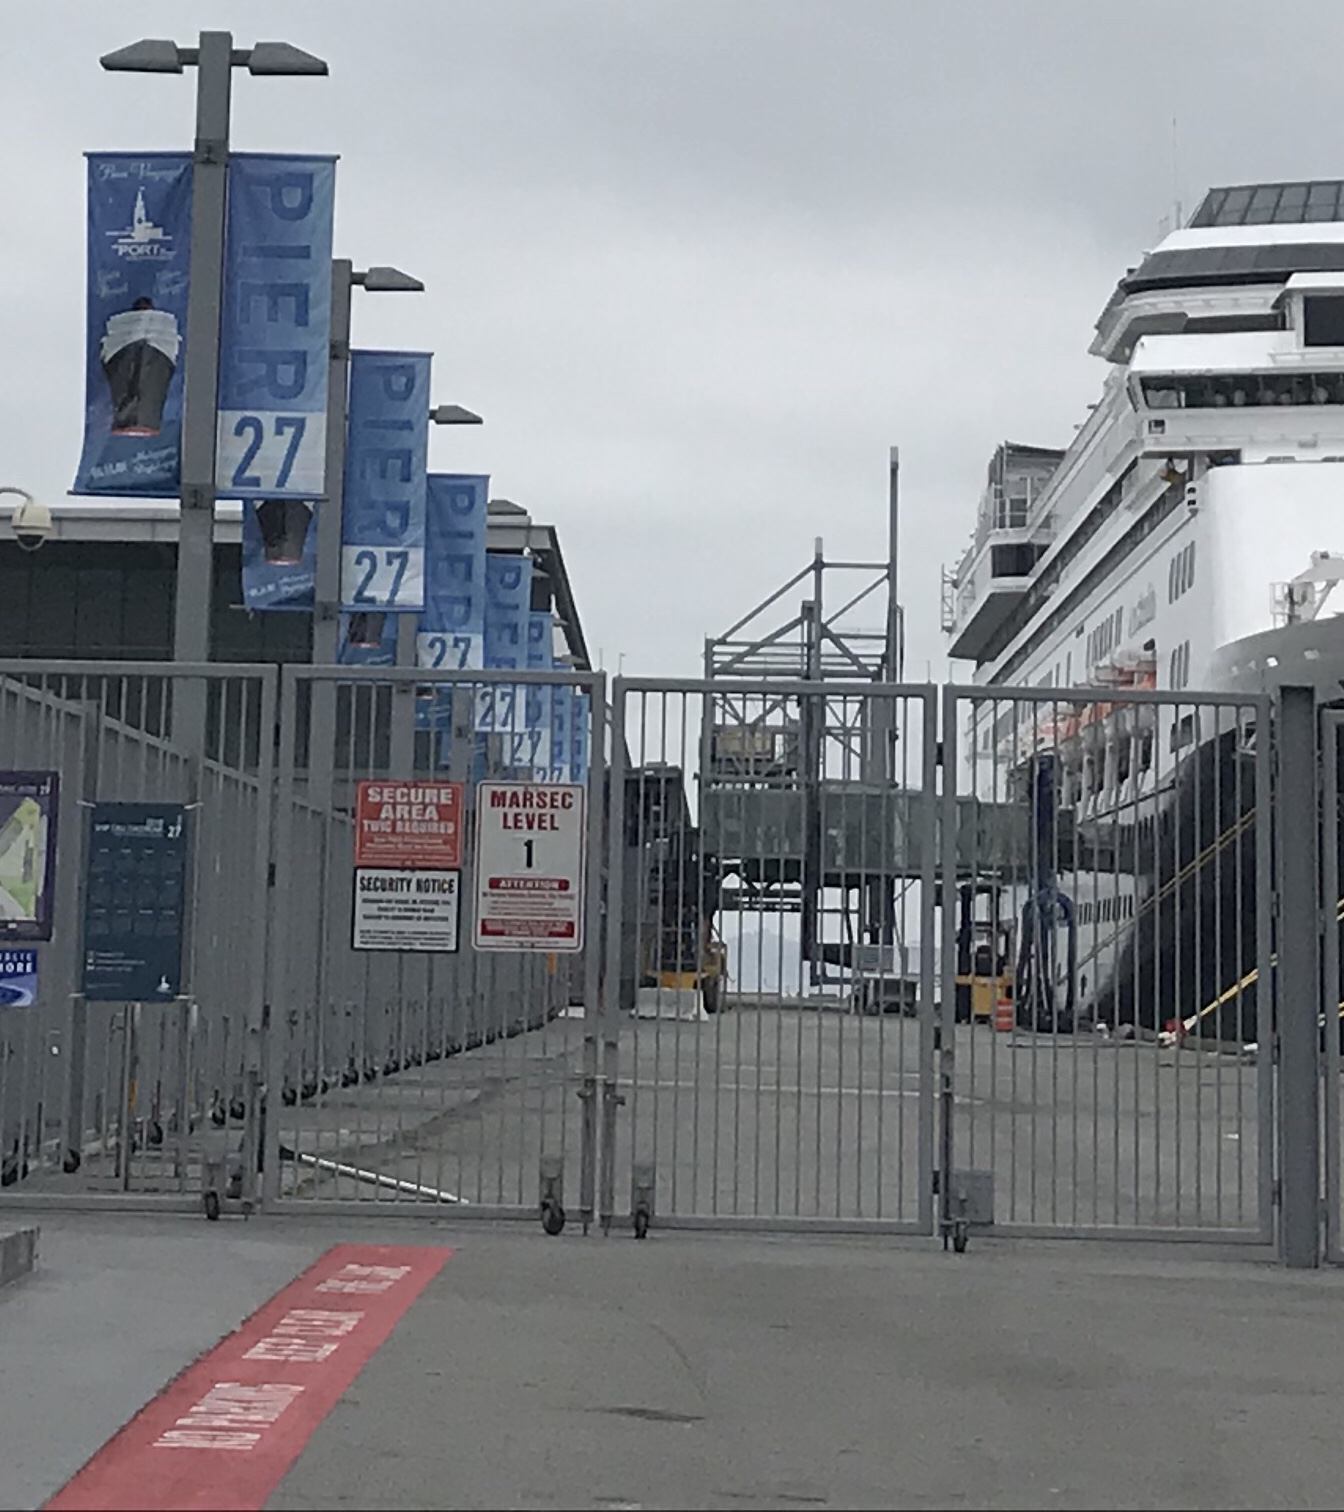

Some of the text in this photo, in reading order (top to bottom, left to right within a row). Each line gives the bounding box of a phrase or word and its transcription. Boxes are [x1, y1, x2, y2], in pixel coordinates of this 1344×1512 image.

[117, 244, 160, 256] PORT
[235, 172, 314, 400] PIER
[231, 415, 307, 488] 27
[358, 364, 416, 543] PIER
[353, 549, 410, 606] 27
[427, 635, 472, 669] 27
[478, 689, 514, 729] 27
[367, 786, 453, 805] SECURE
[490, 790, 574, 809] MARSEC
[380, 804, 440, 820] AREA
[502, 812, 560, 831] LEVEL
[523, 839, 534, 869] 1
[359, 876, 455, 894] SECURITY NOTICE
[499, 879, 560, 889] ATTENTION
[241, 1309, 365, 1363] KEEP CLEAR
[152, 1430, 262, 1450] NO
